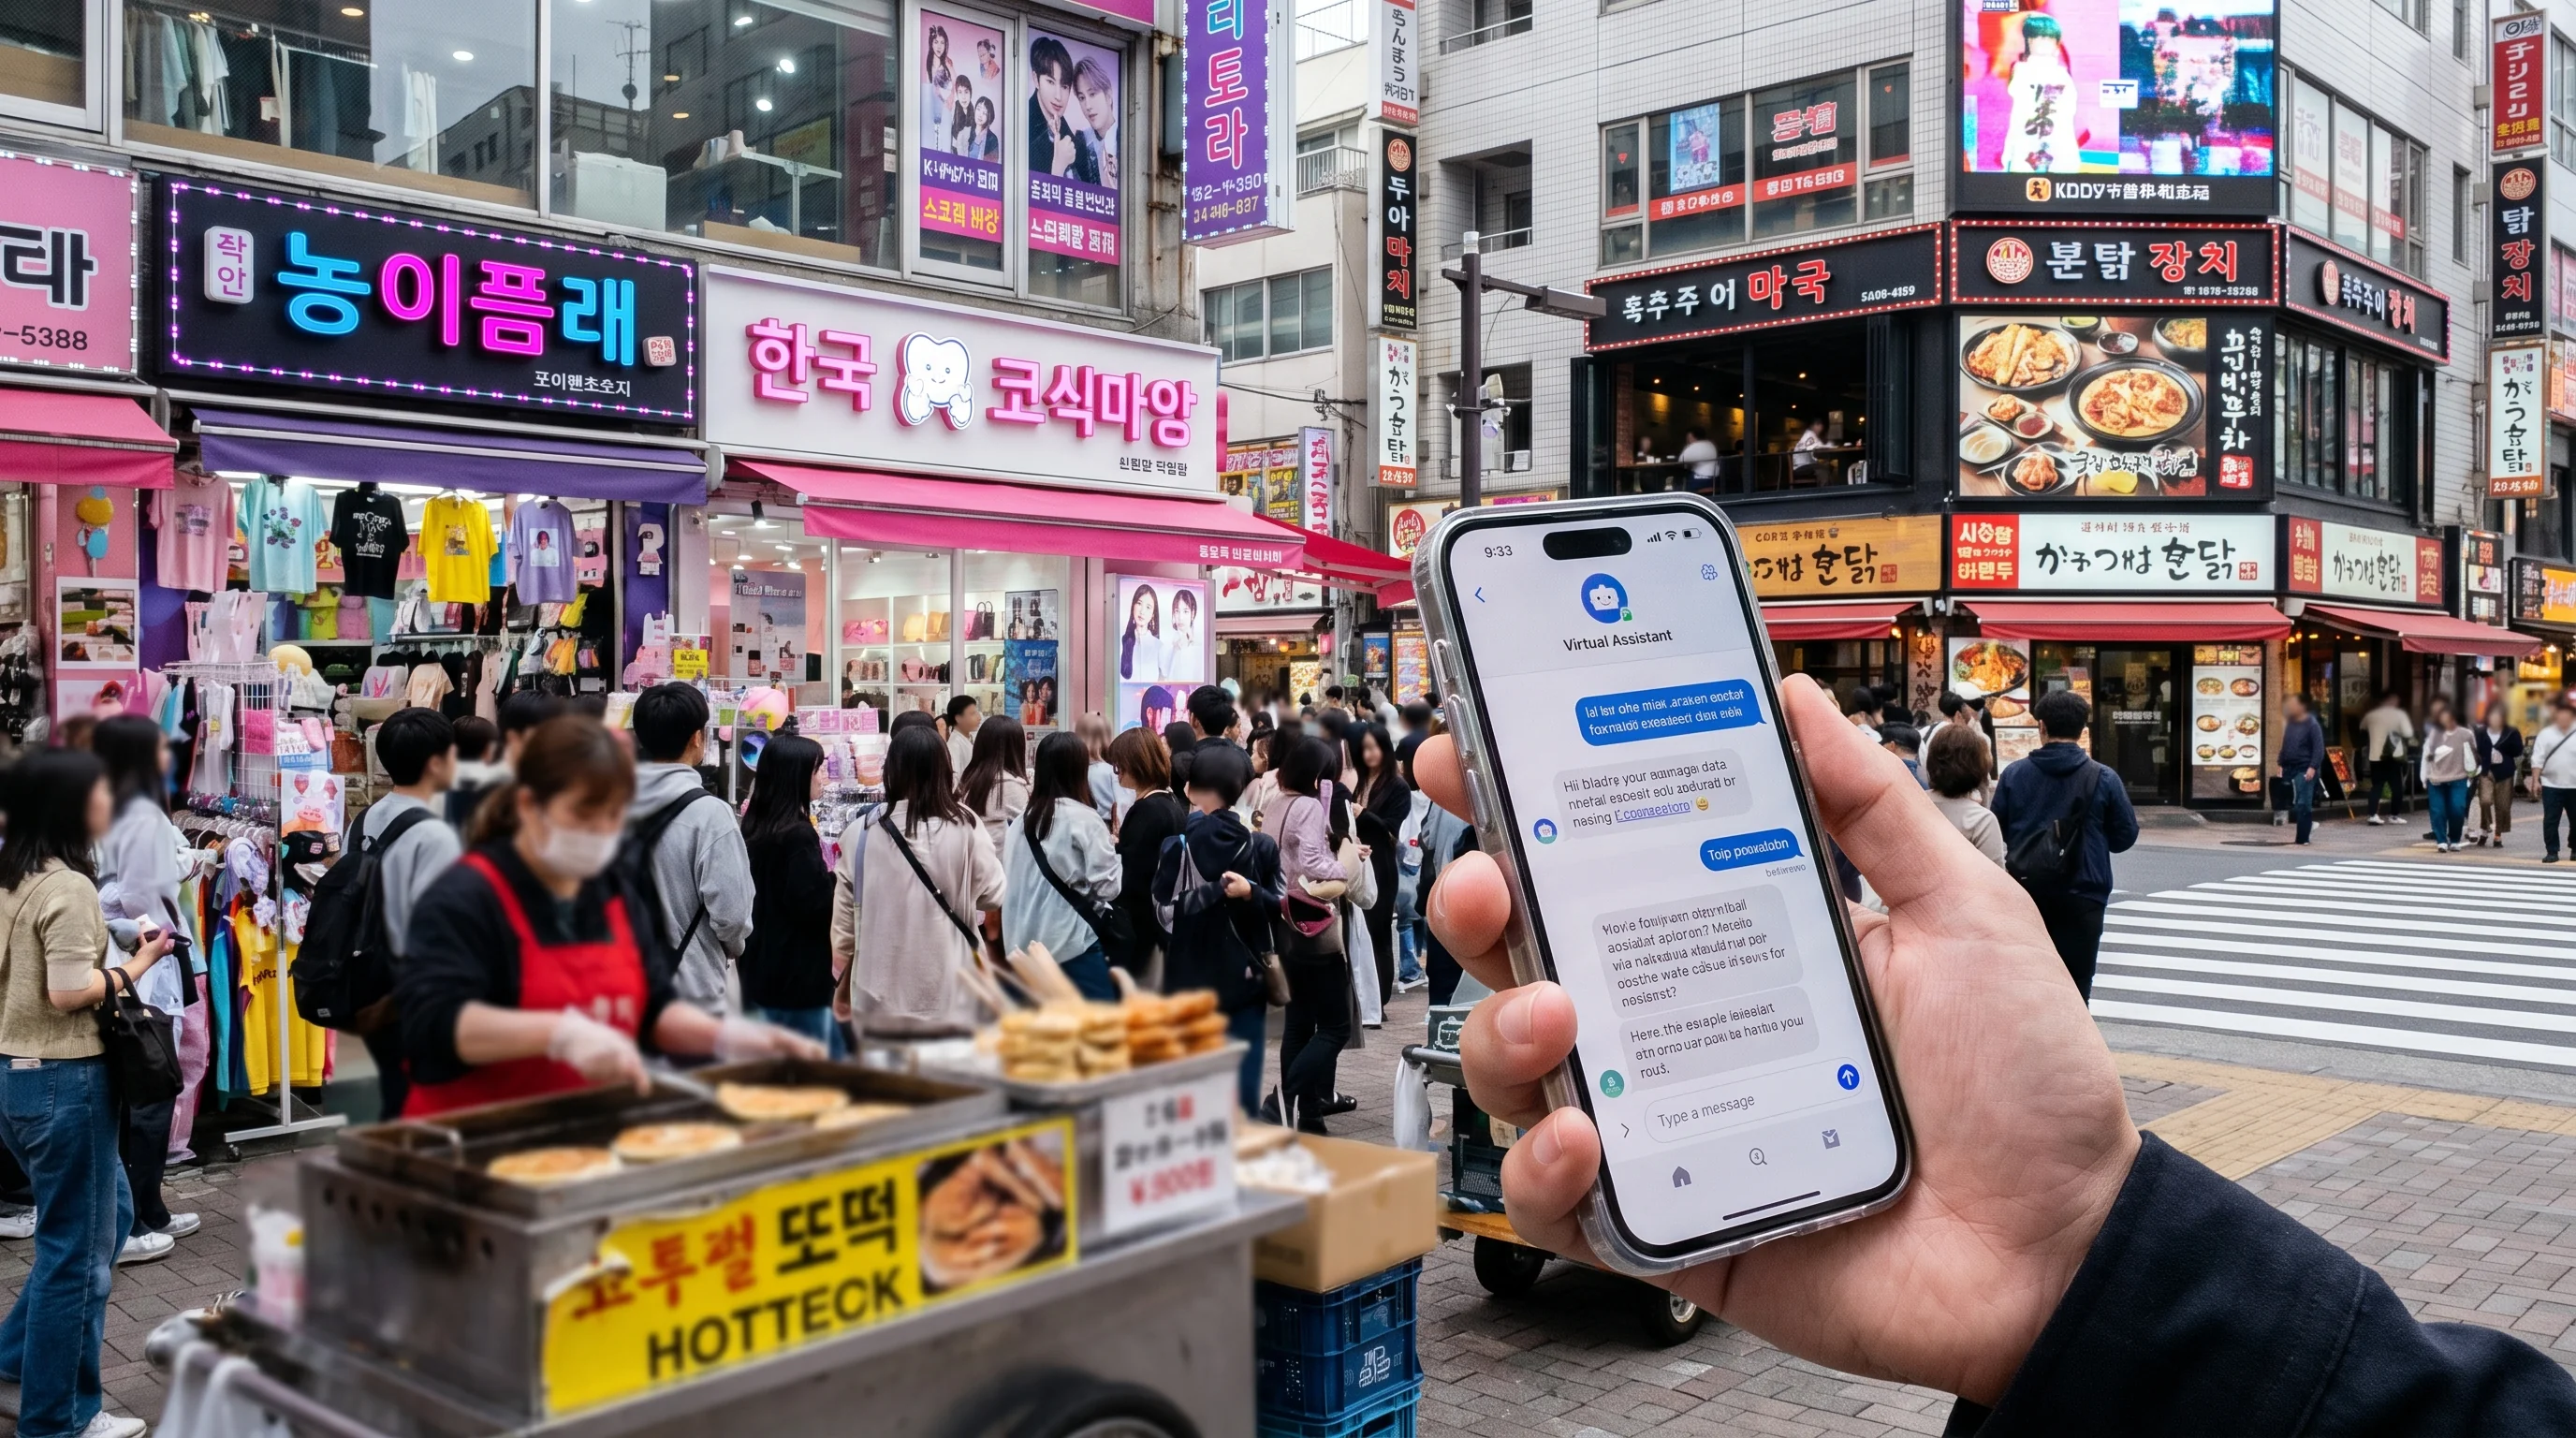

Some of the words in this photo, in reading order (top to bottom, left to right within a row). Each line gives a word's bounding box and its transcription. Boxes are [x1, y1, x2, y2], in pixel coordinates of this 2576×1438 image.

[0, 325, 88, 351] -5388
[746, 317, 878, 412] 한국
[1485, 545, 1513, 558] 9:33
[1563, 635, 1609, 652] Virtual
[1613, 629, 1673, 647] Assistant
[1622, 770, 1647, 787] your
[1702, 759, 1728, 772] data
[1770, 946, 1786, 960] for
[1658, 1111, 1689, 1129] Type
[1691, 1108, 1699, 1119] a
[1702, 1094, 1756, 1118] message
[648, 1268, 903, 1378] HOTTECK
